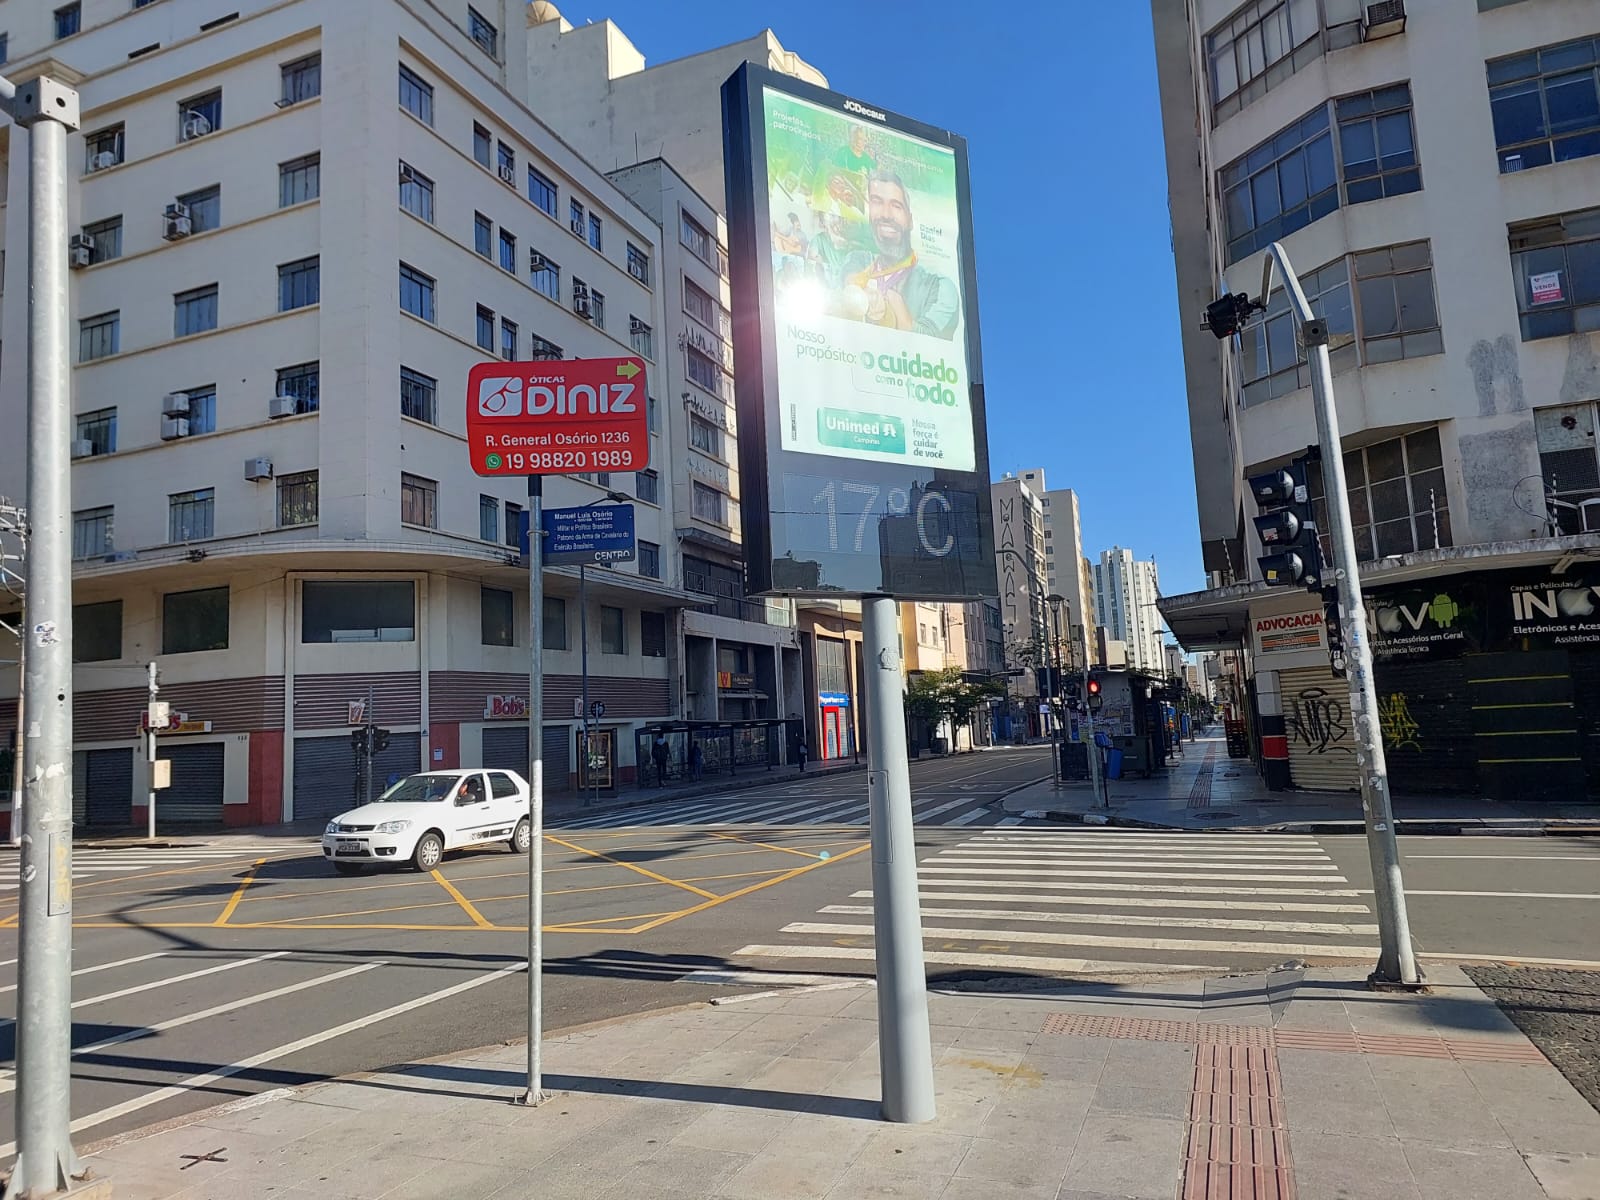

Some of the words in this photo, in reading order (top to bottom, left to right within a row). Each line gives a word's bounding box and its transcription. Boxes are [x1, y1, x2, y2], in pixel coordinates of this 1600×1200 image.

[843, 99, 887, 122] JCDecaux
[787, 324, 826, 344] Nosso
[796, 344, 857, 364] propósito:
[878, 351, 958, 384] cuidado
[529, 376, 565, 384] ÓTICAS
[875, 374, 896, 386] com
[896, 377, 904, 386] o
[527, 384, 636, 415] DINIZ
[826, 416, 880, 435] Unimed
[912, 418, 936, 430] Nossa
[486, 436, 498, 446] R.
[502, 434, 550, 446] General
[555, 432, 598, 444] Osório
[601, 432, 630, 443] 1236
[913, 429, 933, 439] força
[853, 436, 880, 445] Campinas
[913, 438, 938, 448] cuidar
[913, 446, 924, 456] de
[506, 454, 524, 469] 19
[530, 452, 586, 468] 98820
[591, 450, 632, 466] 1989
[554, 512, 576, 520] Manuel
[594, 550, 630, 561] CENTRO
[1510, 584, 1533, 592] Capas
[1256, 612, 1322, 632] ADVOCACIA
[1513, 624, 1568, 634] Eletrônicos
[1393, 635, 1429, 645] Acessórios
[1443, 631, 1464, 640] Geral
[1554, 634, 1600, 644] Assistência
[1377, 647, 1408, 655] Assistência
